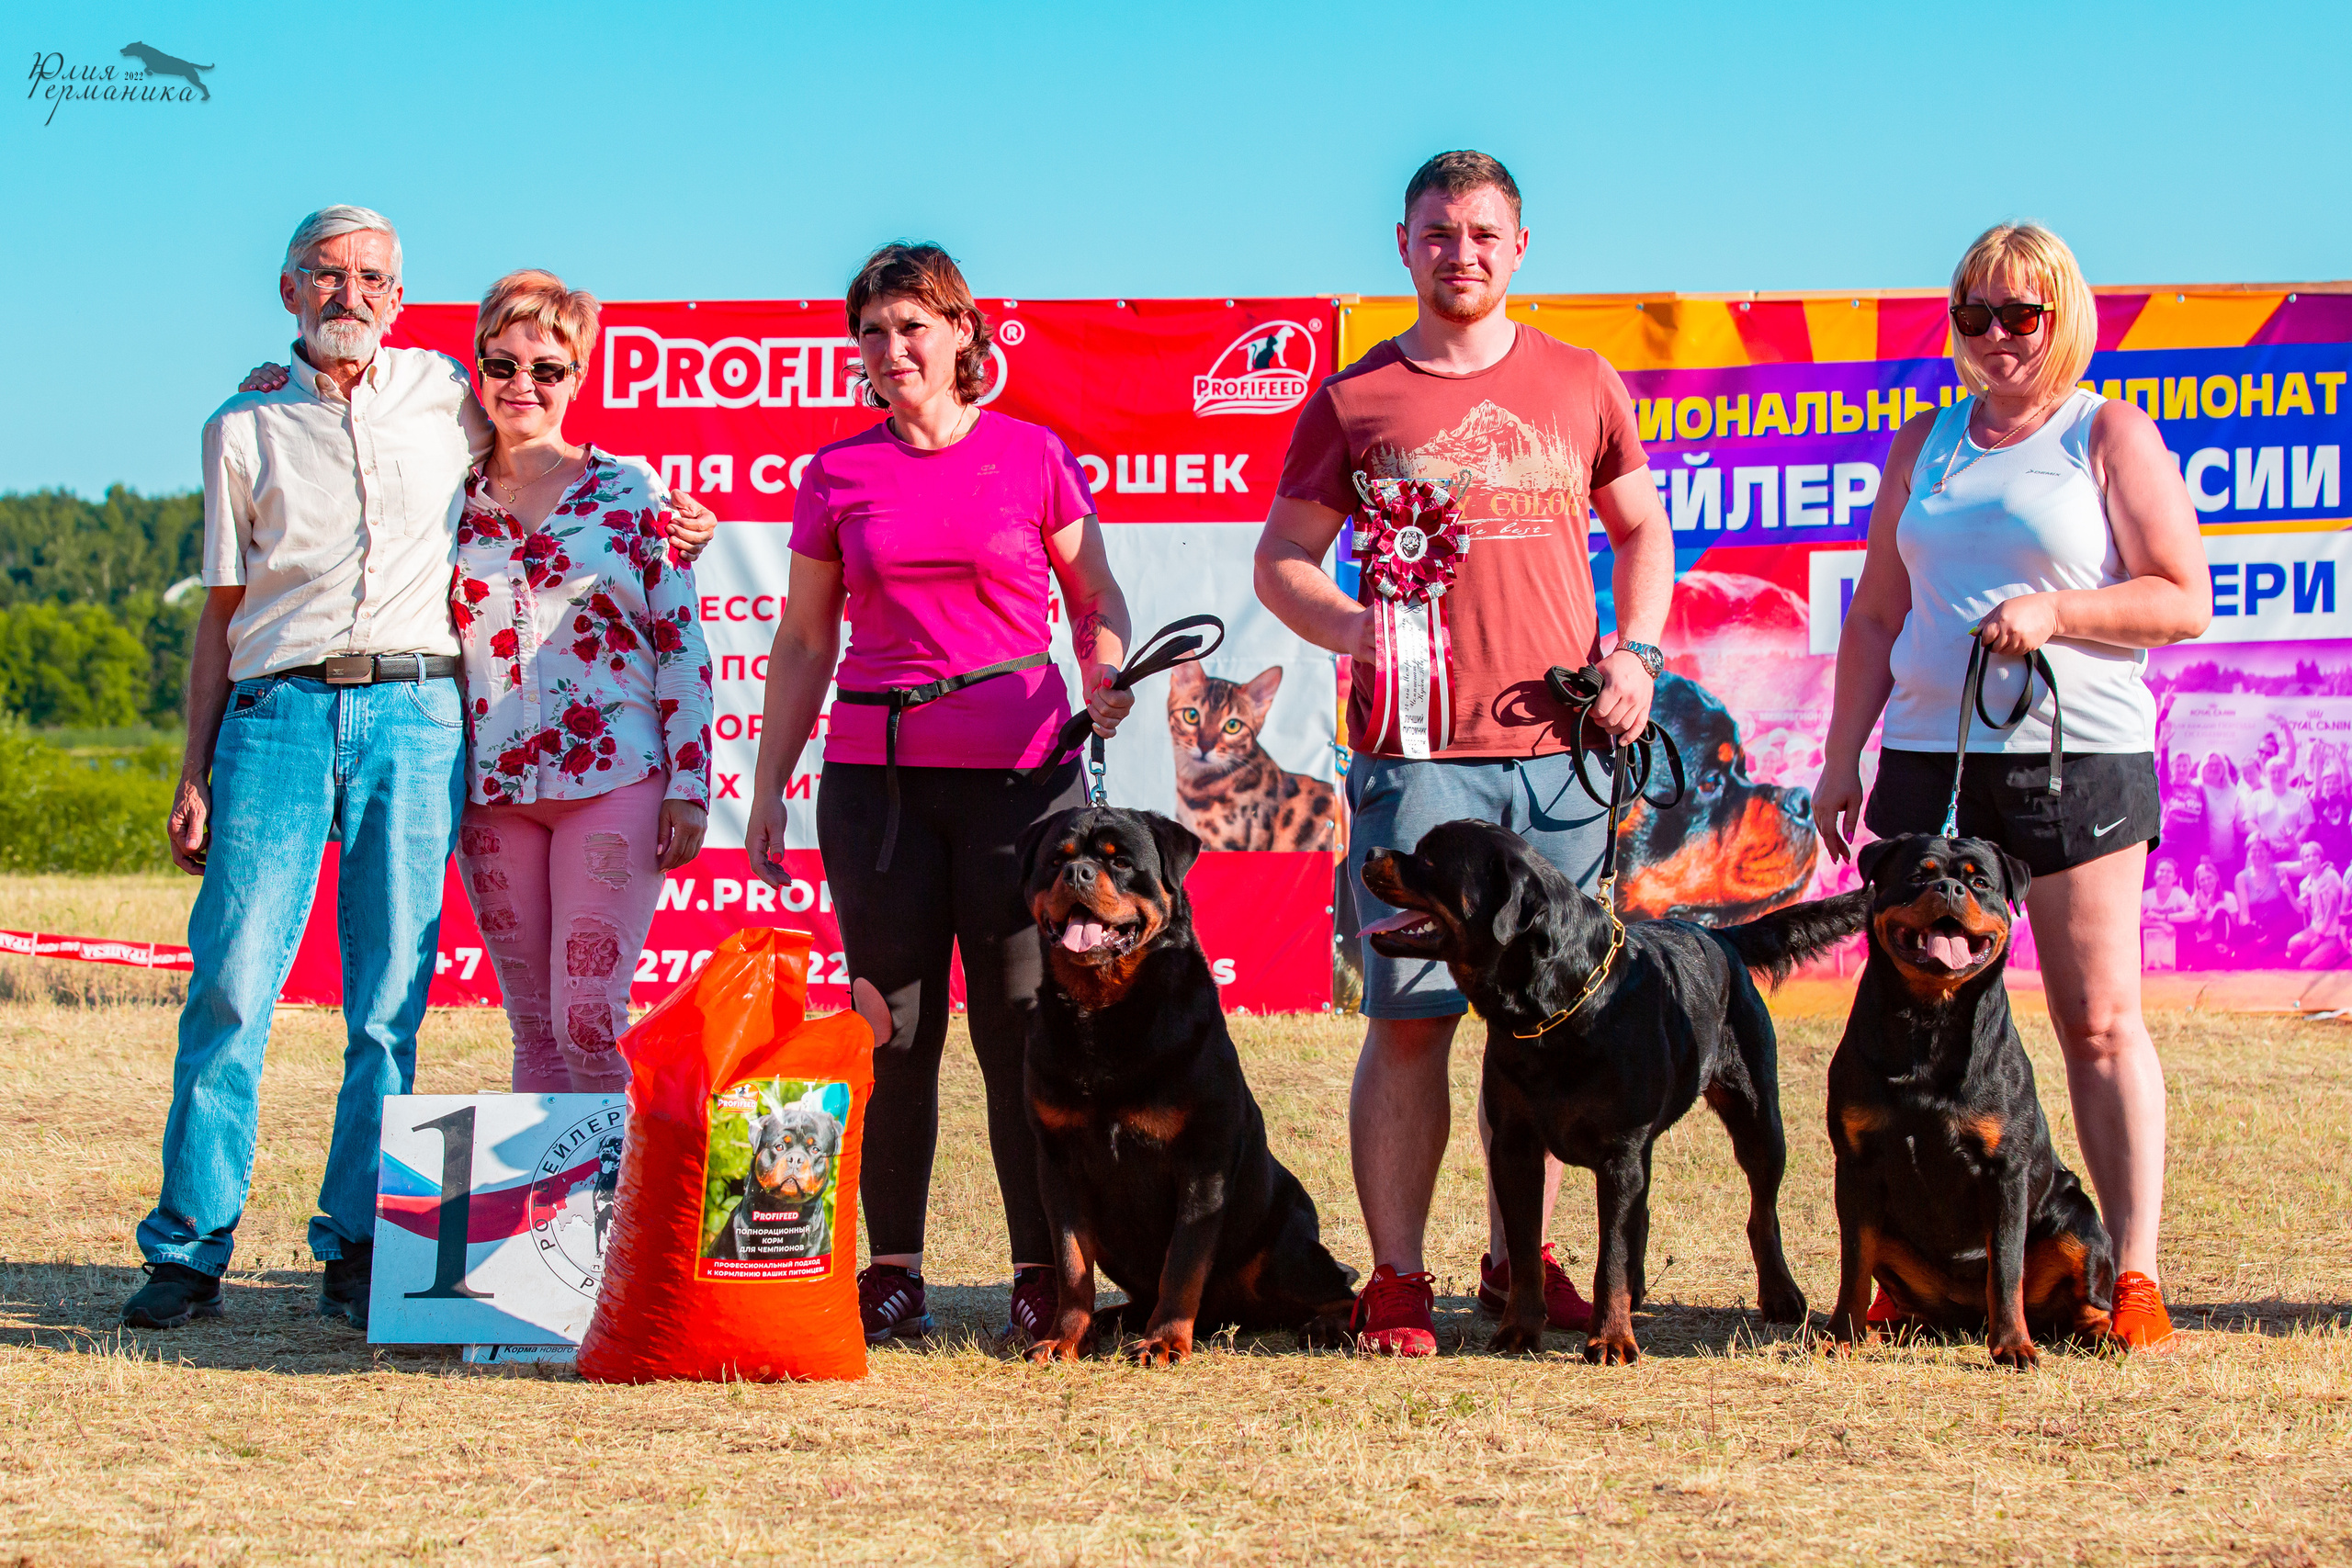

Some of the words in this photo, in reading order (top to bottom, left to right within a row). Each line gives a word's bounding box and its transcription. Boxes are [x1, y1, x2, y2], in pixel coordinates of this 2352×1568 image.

[1193, 375, 1308, 400] PROFIFEED
[627, 454, 734, 493] ЛЯ
[1077, 454, 1250, 493] ОШЕК
[1499, 522, 1541, 535] best
[2209, 560, 2335, 617] ЕРИ
[2280, 721, 2312, 731] OYAL
[2316, 721, 2351, 731] CANIN
[718, 1099, 756, 1109] PROFIFEED
[404, 1106, 494, 1299] 1
[752, 1211, 799, 1222] PROFIFEED
[736, 1224, 810, 1235] ПОЛНОРАЦИОННЫЙ
[757, 1244, 805, 1253] ЧЕМПИОНОВ
[714, 1260, 793, 1269] ПРОФЕССИОНАЛЬНЫЙ
[794, 1258, 820, 1268] ПОДХОД
[714, 1269, 761, 1278] КОРМЛЕНИЮ
[762, 1269, 787, 1278] ВАШИХ
[504, 1345, 537, 1355] Корма
[539, 1346, 573, 1354] нового
